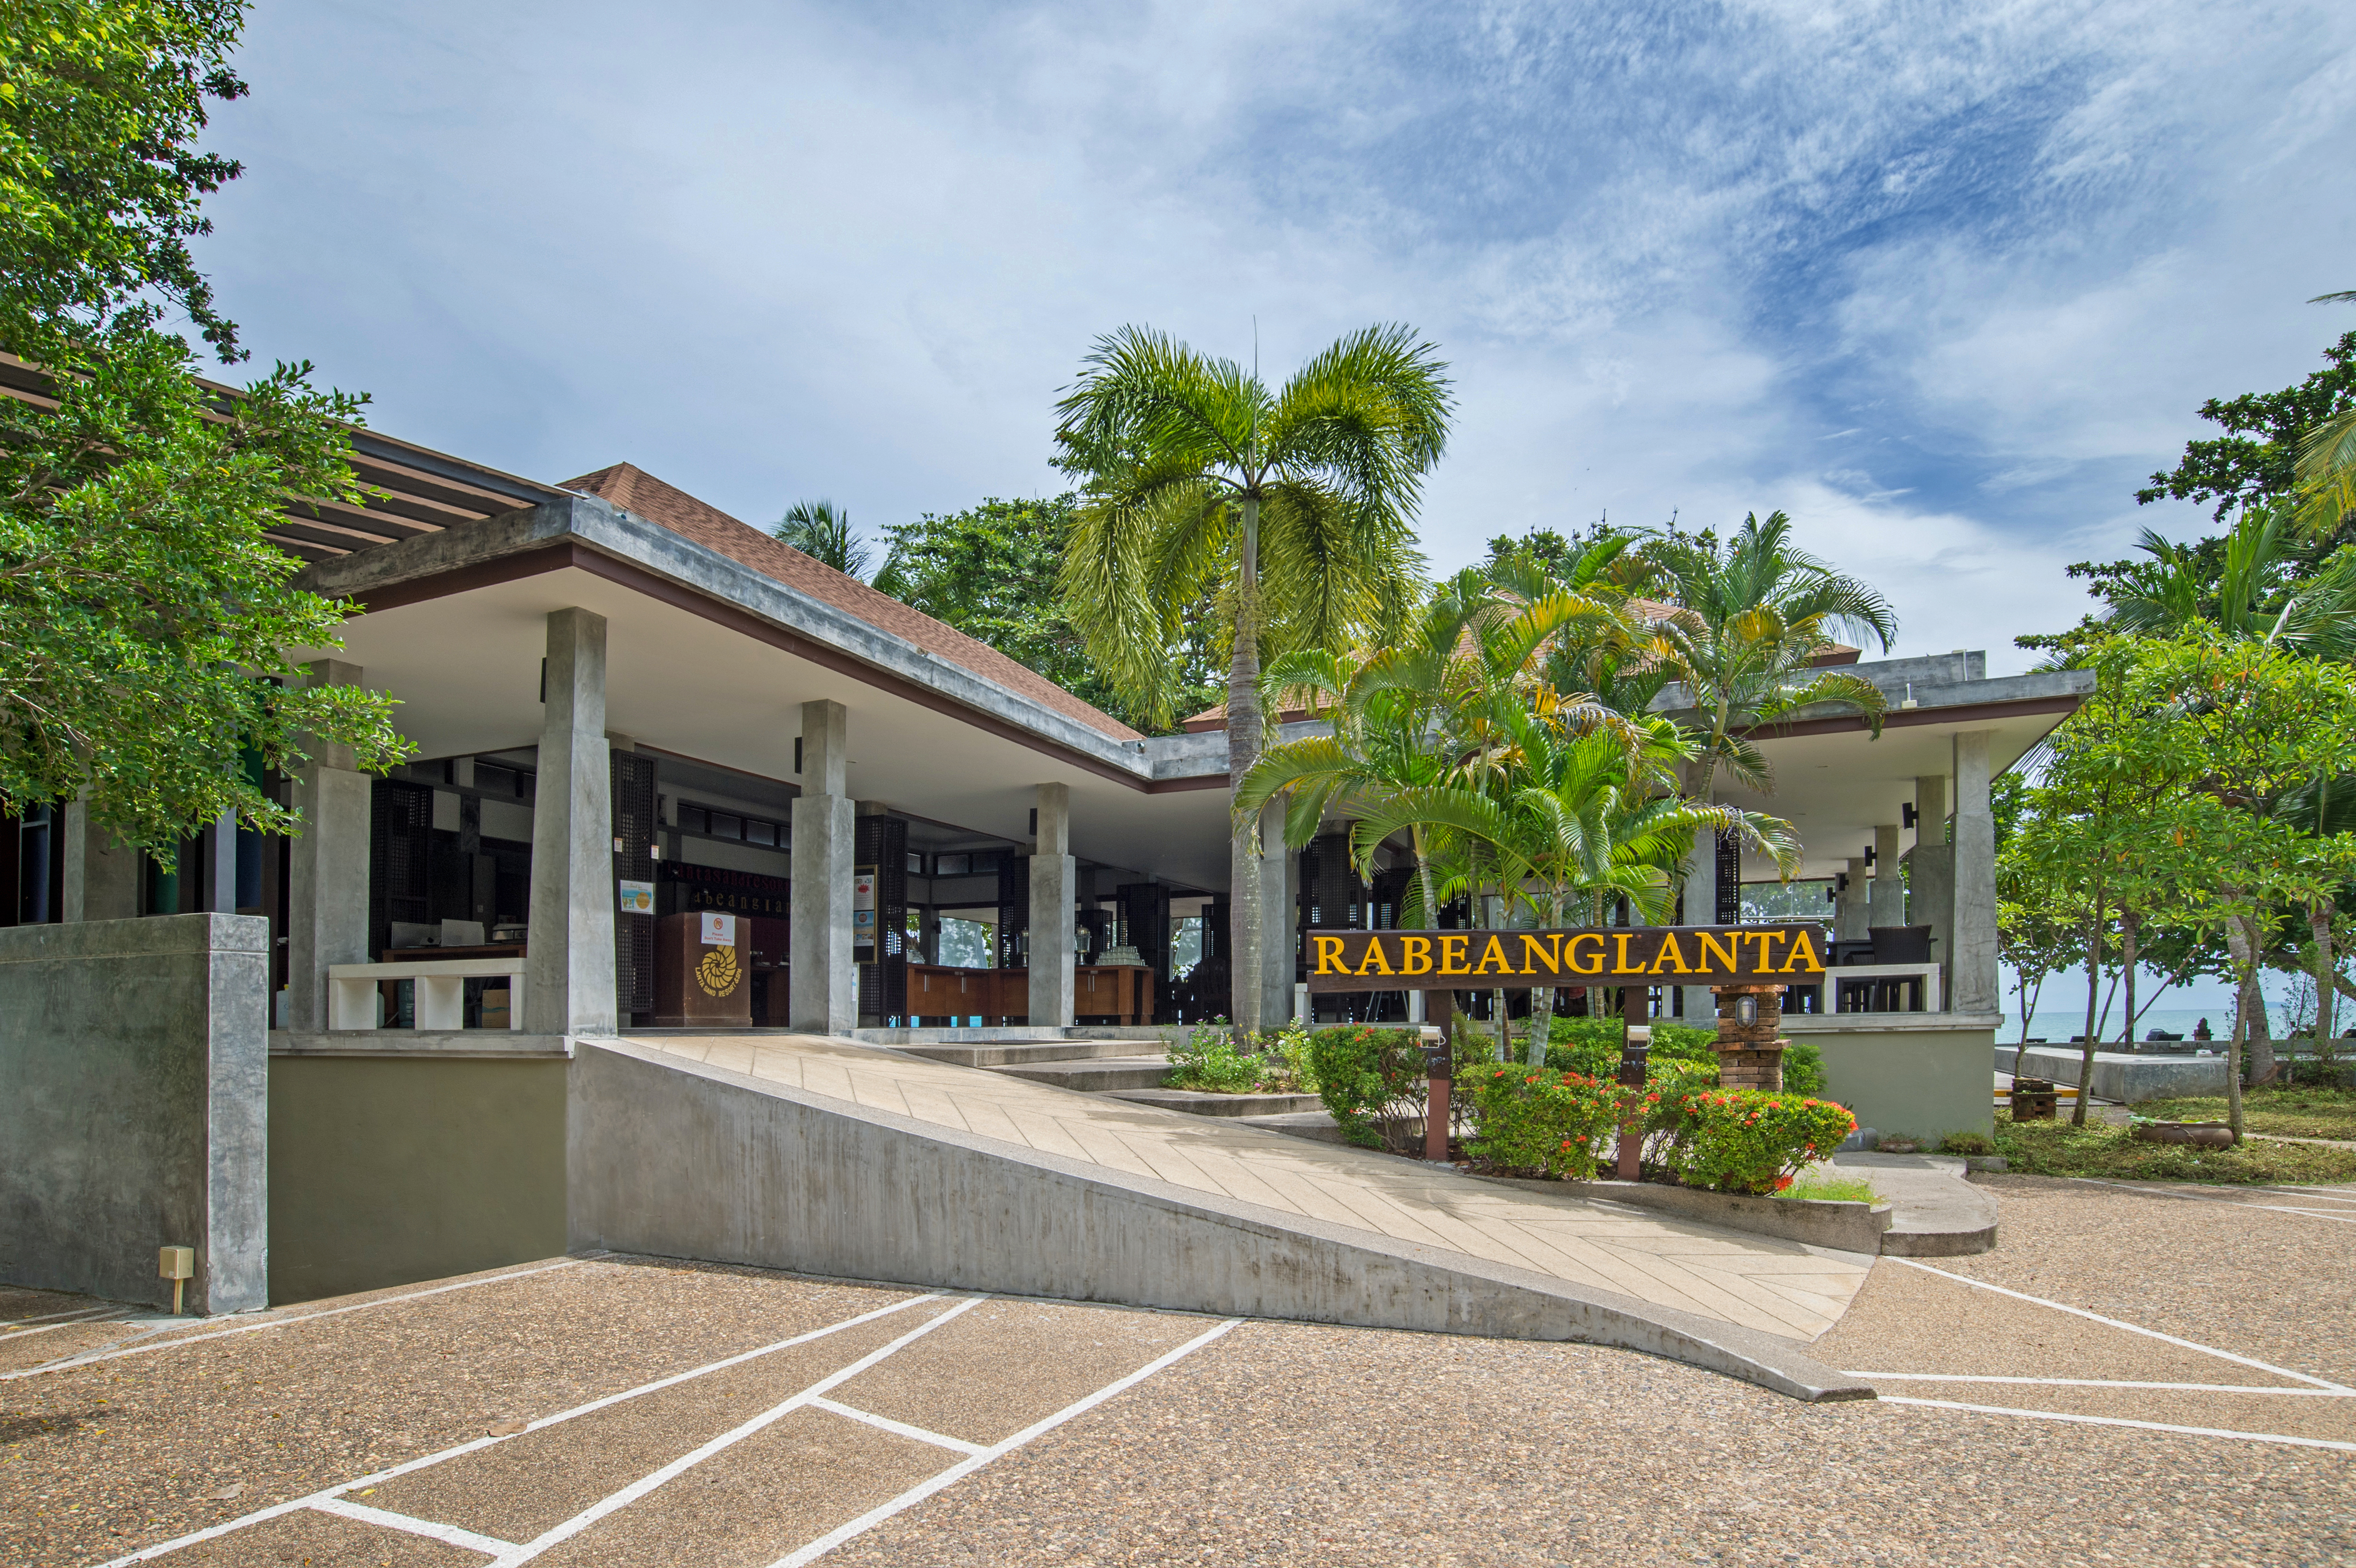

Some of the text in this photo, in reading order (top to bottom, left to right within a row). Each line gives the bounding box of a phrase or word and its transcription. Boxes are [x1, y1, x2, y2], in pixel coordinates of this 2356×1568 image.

[1313, 930, 1826, 975] RABEANGLANTA
[695, 967, 705, 988] LANTA
[704, 985, 716, 997] SAND
[719, 983, 736, 997] RESORT
